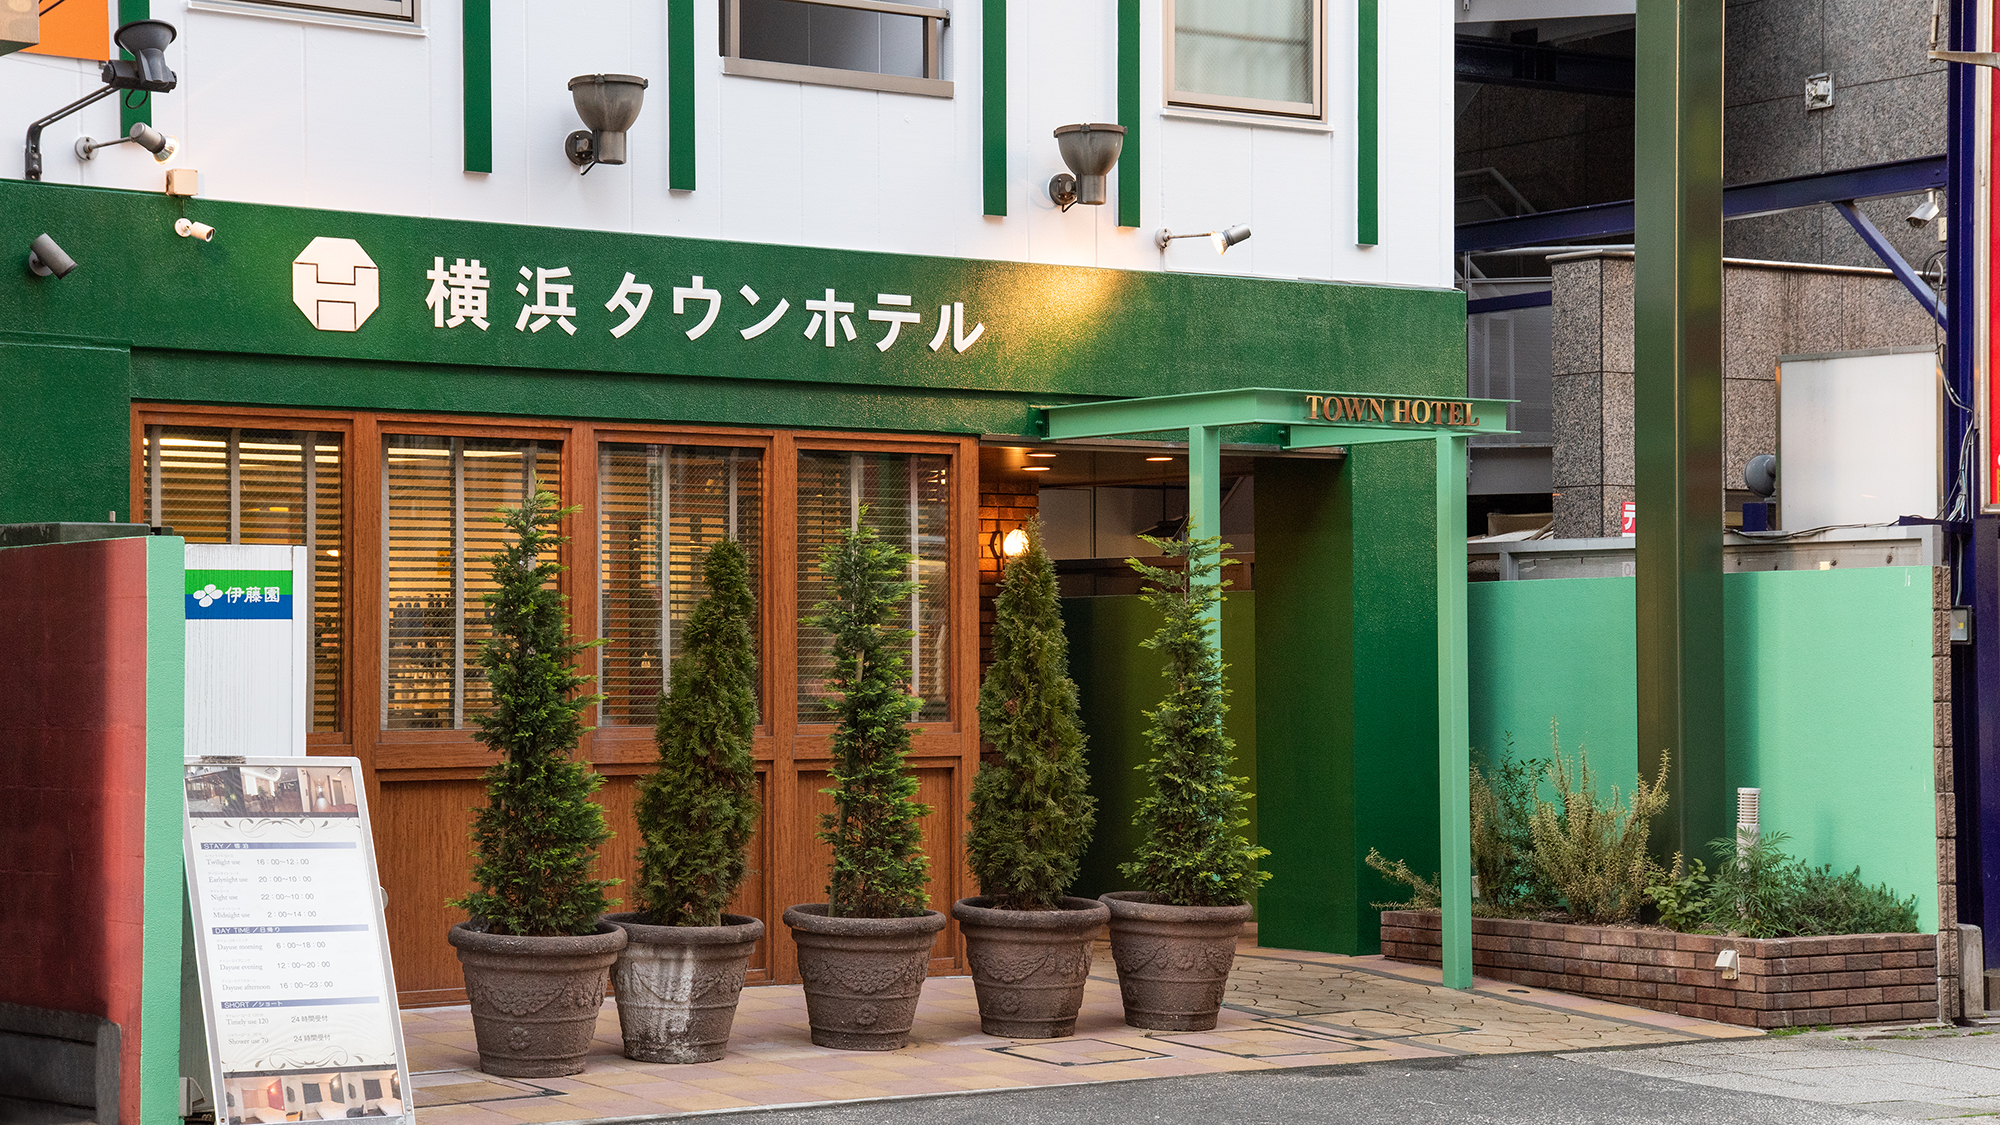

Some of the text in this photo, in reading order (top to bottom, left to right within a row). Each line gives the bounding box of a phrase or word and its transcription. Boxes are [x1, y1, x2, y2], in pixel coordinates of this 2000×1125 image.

[1305, 395, 1480, 427] TOWN HOTEL
[225, 586, 280, 604] 伊藤園
[206, 859, 230, 867] Twilight
[208, 876, 240, 884] Earlynight
[211, 894, 228, 902] Night
[213, 911, 240, 920] Midnight
[217, 943, 238, 952] Dayuse
[239, 943, 263, 951] morning
[219, 963, 240, 972] Dayuse
[222, 984, 243, 992] Dayuse
[244, 983, 271, 991] afternoon
[224, 1001, 250, 1009] SHORT
[226, 1018, 246, 1026] Timely
[228, 1037, 250, 1045] Shower
